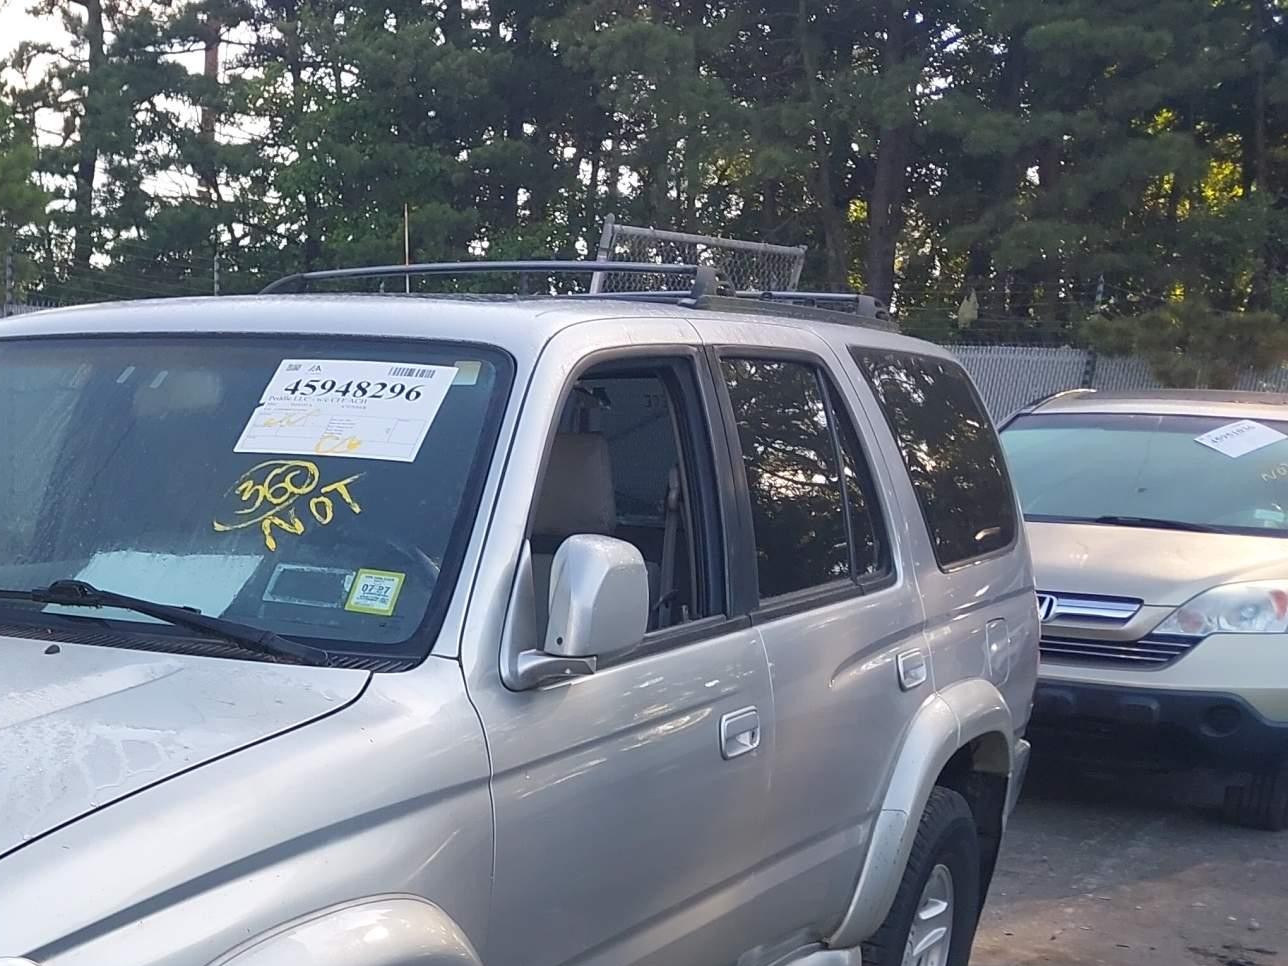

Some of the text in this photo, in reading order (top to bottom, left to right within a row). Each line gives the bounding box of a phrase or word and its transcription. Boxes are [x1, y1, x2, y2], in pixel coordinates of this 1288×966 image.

[285, 378, 426, 402] 45948296
[232, 461, 320, 515] 360
[261, 472, 368, 552] NOT
